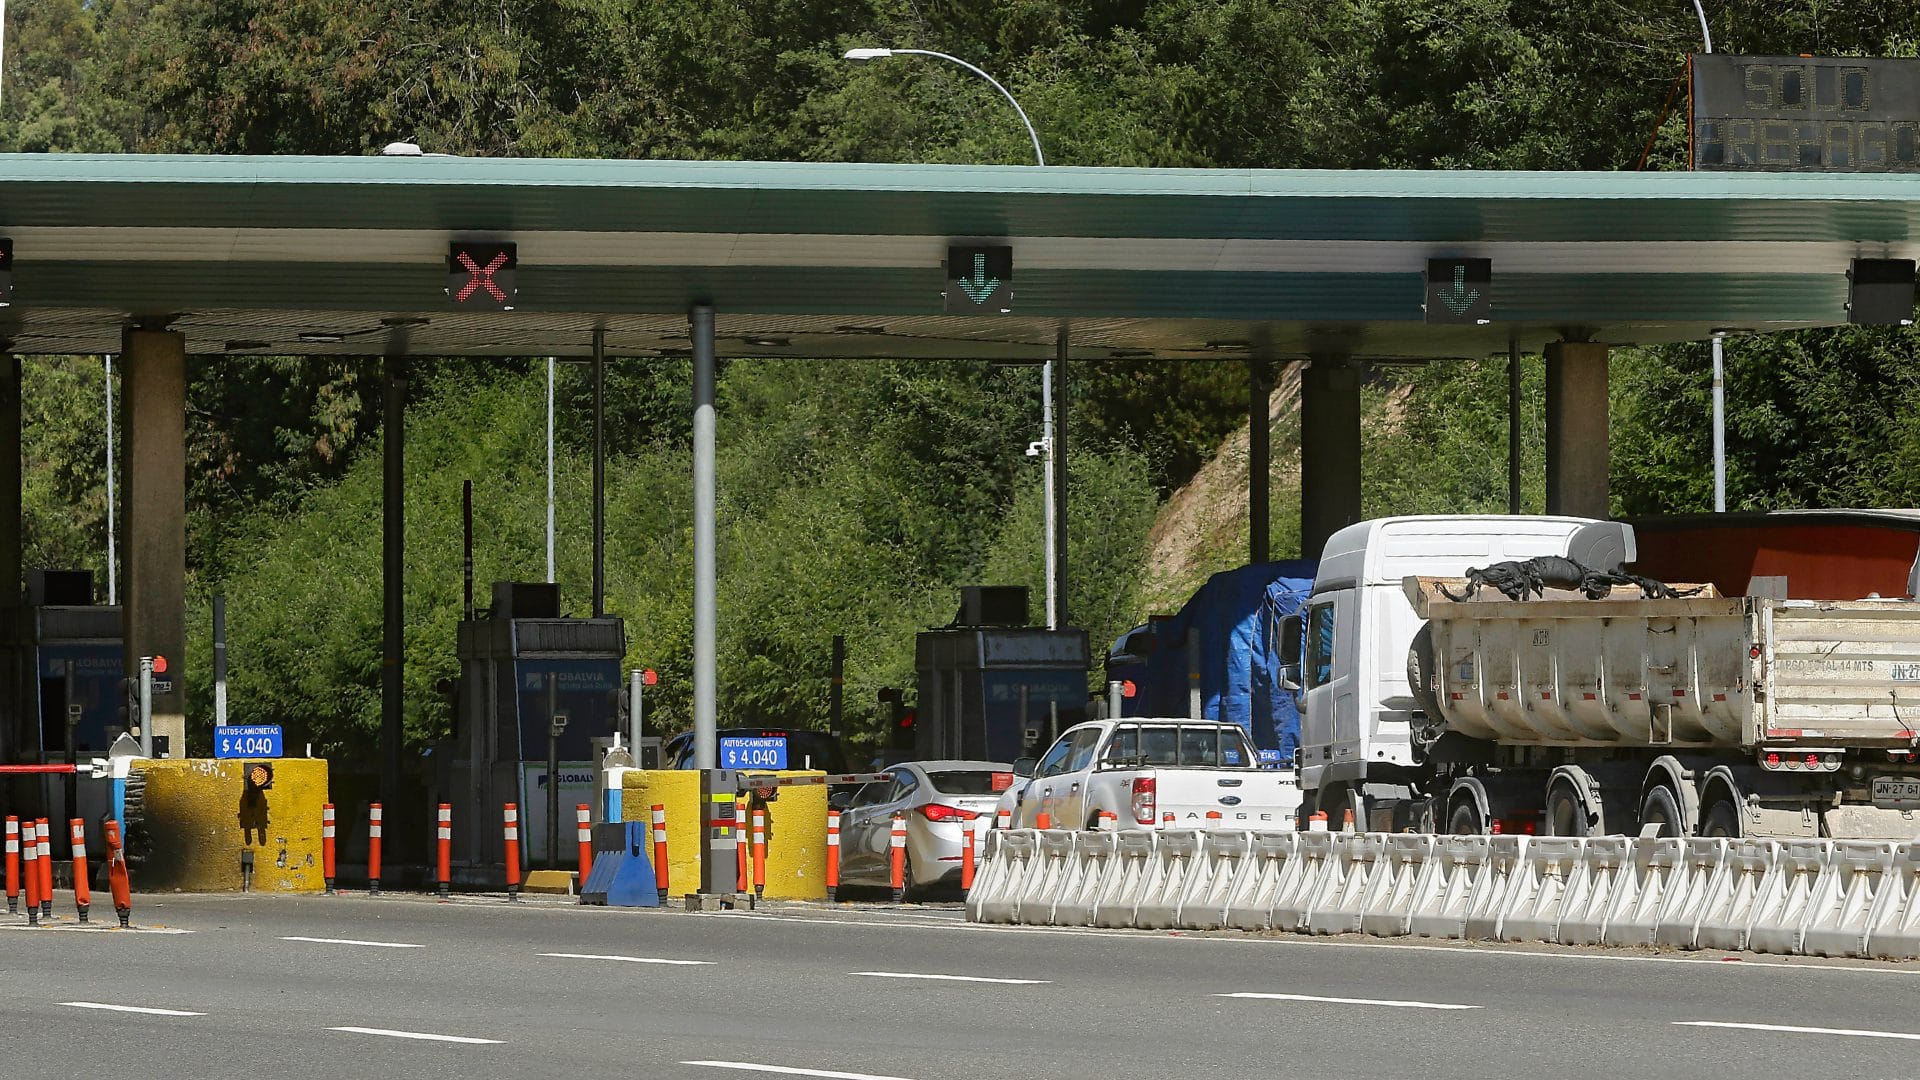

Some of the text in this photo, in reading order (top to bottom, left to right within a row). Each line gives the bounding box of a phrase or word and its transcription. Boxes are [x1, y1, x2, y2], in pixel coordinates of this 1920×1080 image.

[1745, 64, 1870, 112] SOLO
[1696, 118, 1918, 167] PREPAGO
[1854, 661, 1874, 672] MTS
[222, 737, 272, 754] $ 4.040
[728, 749, 777, 765] $ 4.040
[1163, 812, 1298, 822] AGER
